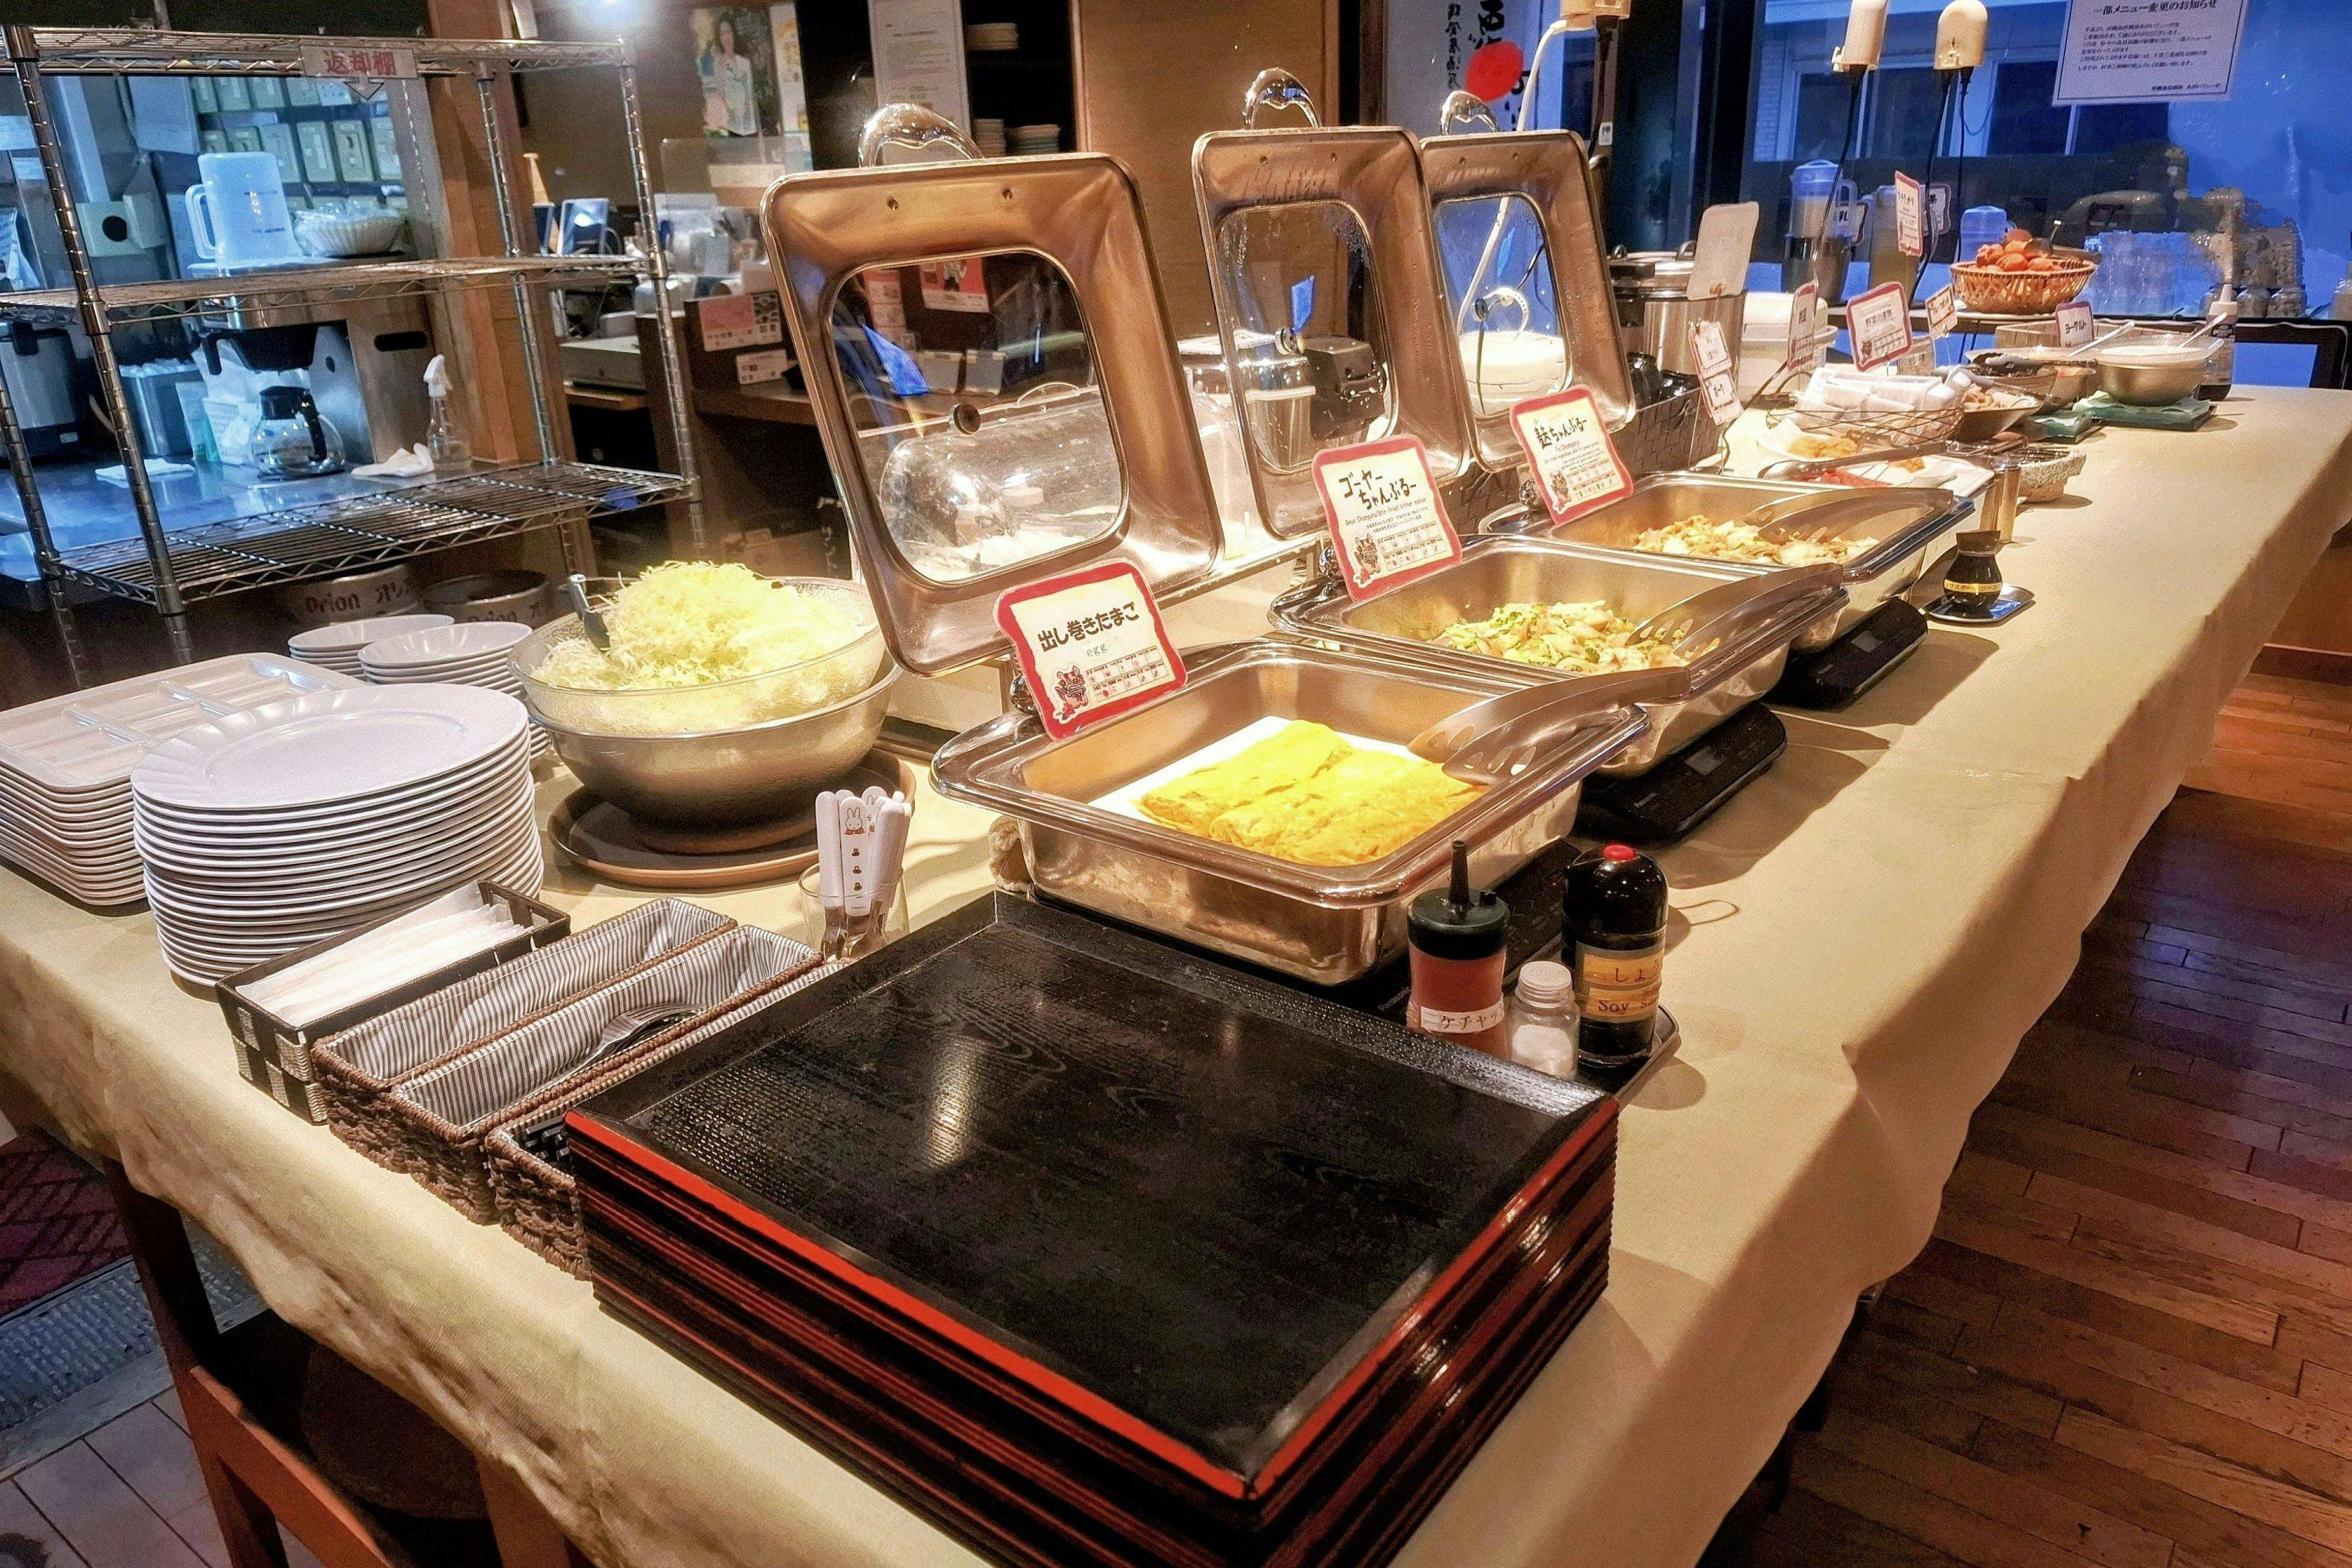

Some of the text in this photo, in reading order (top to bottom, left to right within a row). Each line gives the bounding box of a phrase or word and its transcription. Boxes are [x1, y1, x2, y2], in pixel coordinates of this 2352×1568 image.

[322, 49, 396, 75] 返却棚
[2064, 318, 2087, 334] ヨーグルト
[1338, 470, 1383, 499] ゴーヤー
[1037, 601, 1140, 652] 出し巻きたまご
[1087, 642, 1109, 658] egg
[1441, 1012, 1498, 1030] ケチャッ
